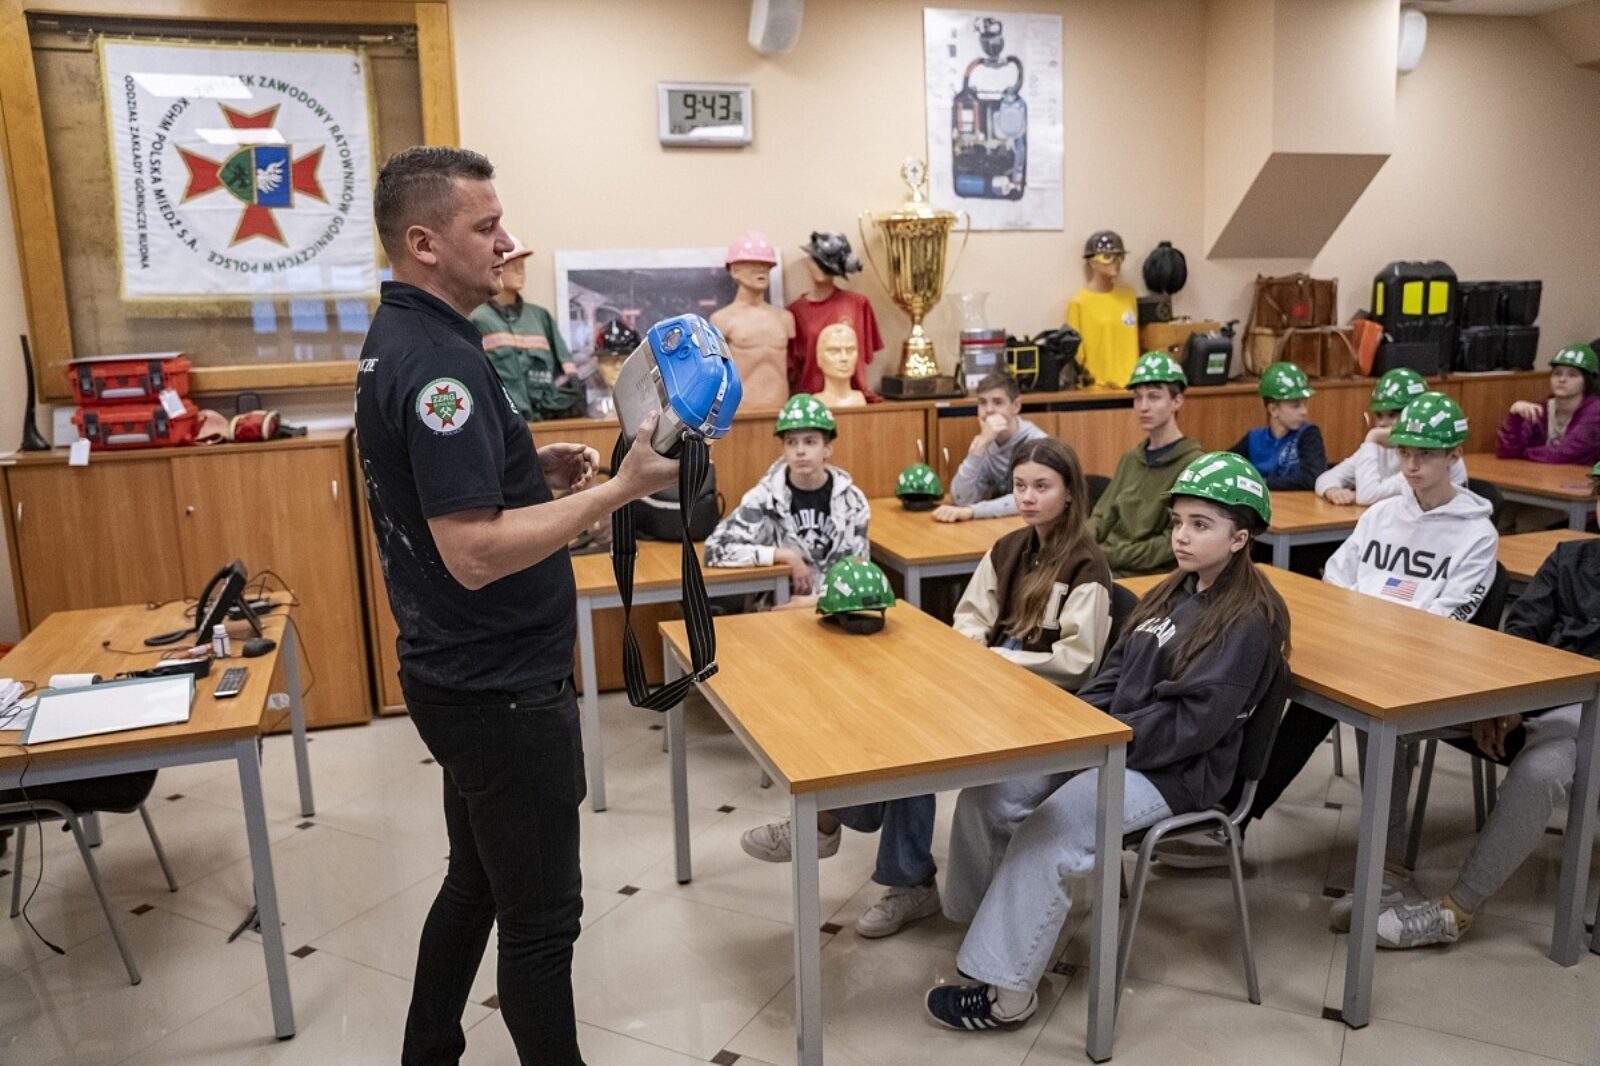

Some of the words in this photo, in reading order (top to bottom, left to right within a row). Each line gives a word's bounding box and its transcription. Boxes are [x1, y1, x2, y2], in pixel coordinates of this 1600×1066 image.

[158, 97, 191, 132] KGHM
[259, 75, 334, 124] ZAWODOWY
[683, 93, 731, 121] 9:43
[149, 132, 167, 185] POLSKA
[176, 229, 199, 252] S.A.
[207, 250, 259, 273] POLSCE
[262, 261, 274, 272] W
[1362, 539, 1452, 581] NASA
